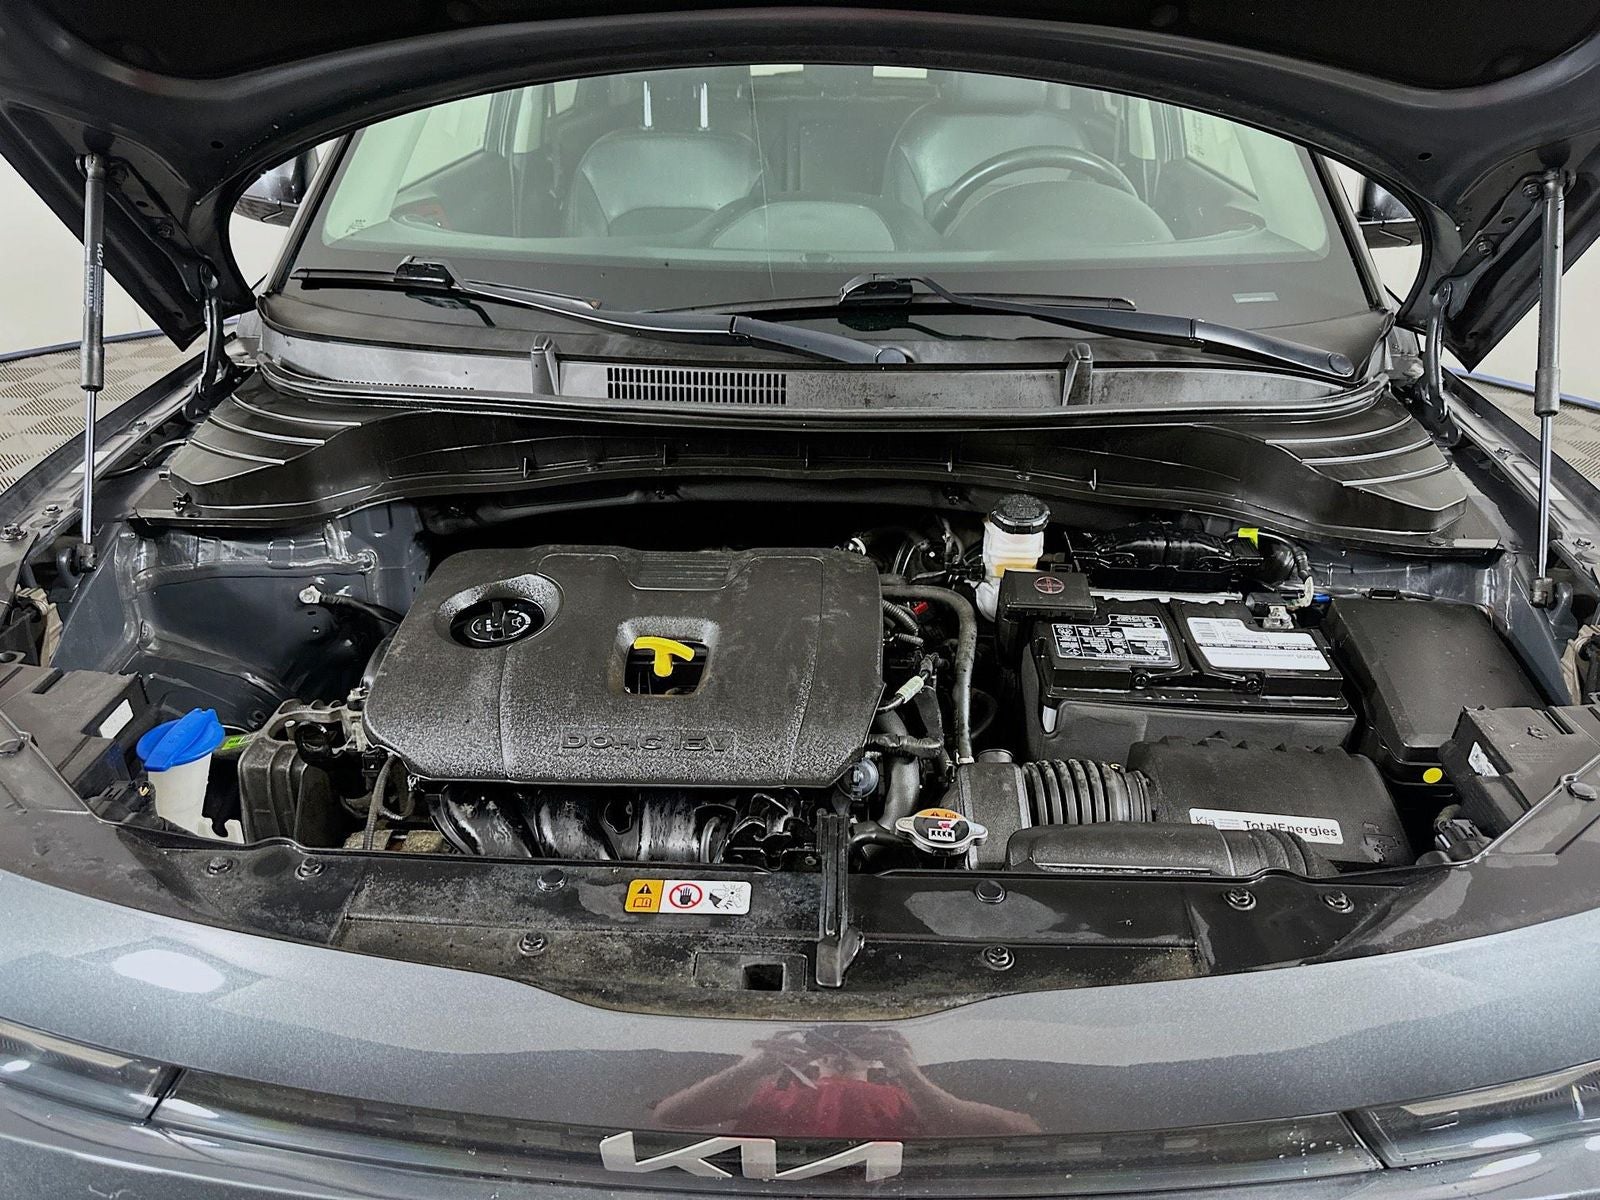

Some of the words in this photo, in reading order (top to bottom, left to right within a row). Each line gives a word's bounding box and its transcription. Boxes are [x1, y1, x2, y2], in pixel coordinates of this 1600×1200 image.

[561, 734, 664, 750] DOHC
[1195, 815, 1216, 826] Kia
[1243, 820, 1338, 837] TotalEnergies
[599, 1131, 903, 1182] KIA
